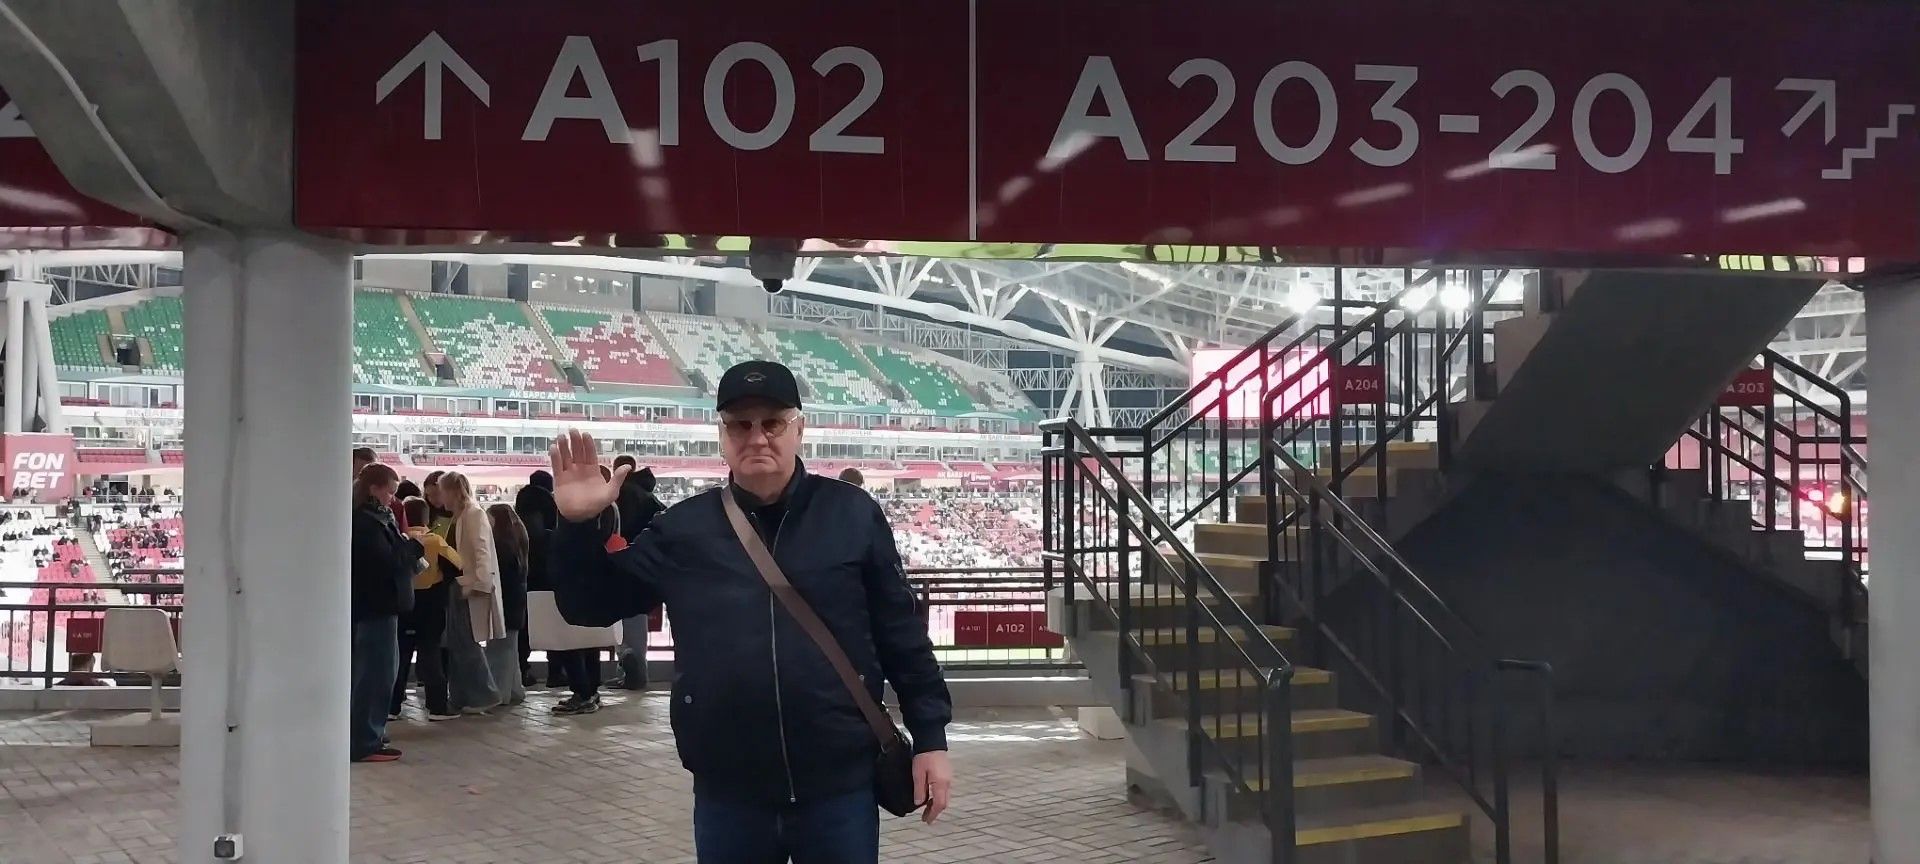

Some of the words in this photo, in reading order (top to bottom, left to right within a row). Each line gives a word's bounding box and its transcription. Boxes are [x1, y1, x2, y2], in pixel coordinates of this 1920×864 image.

[521, 35, 884, 153] A102
[1044, 55, 1744, 174] A203-204
[1344, 379, 1379, 391] A204
[1726, 382, 1765, 393] A203
[13, 452, 65, 470] FON
[13, 471, 65, 489] BET
[995, 624, 1025, 633] A102
